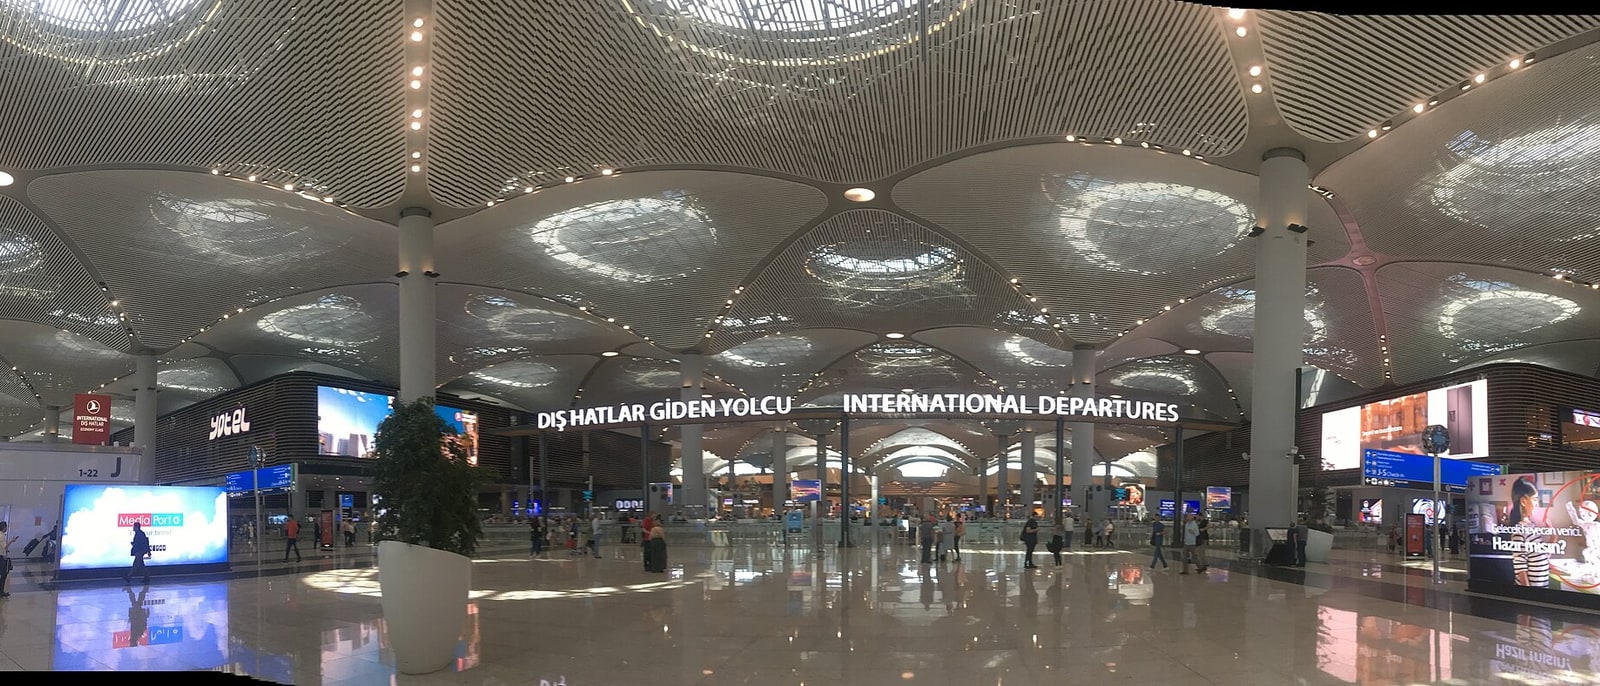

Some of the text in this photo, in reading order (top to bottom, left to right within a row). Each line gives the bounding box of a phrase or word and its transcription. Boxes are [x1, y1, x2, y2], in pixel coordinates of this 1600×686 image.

[538, 396, 792, 432] DIŞ HATLAR GİDEN YOLCU
[843, 393, 1179, 422] INTERNATIONAL DEPARTURES
[79, 469, 98, 477] 1-22
[110, 457, 121, 477] J
